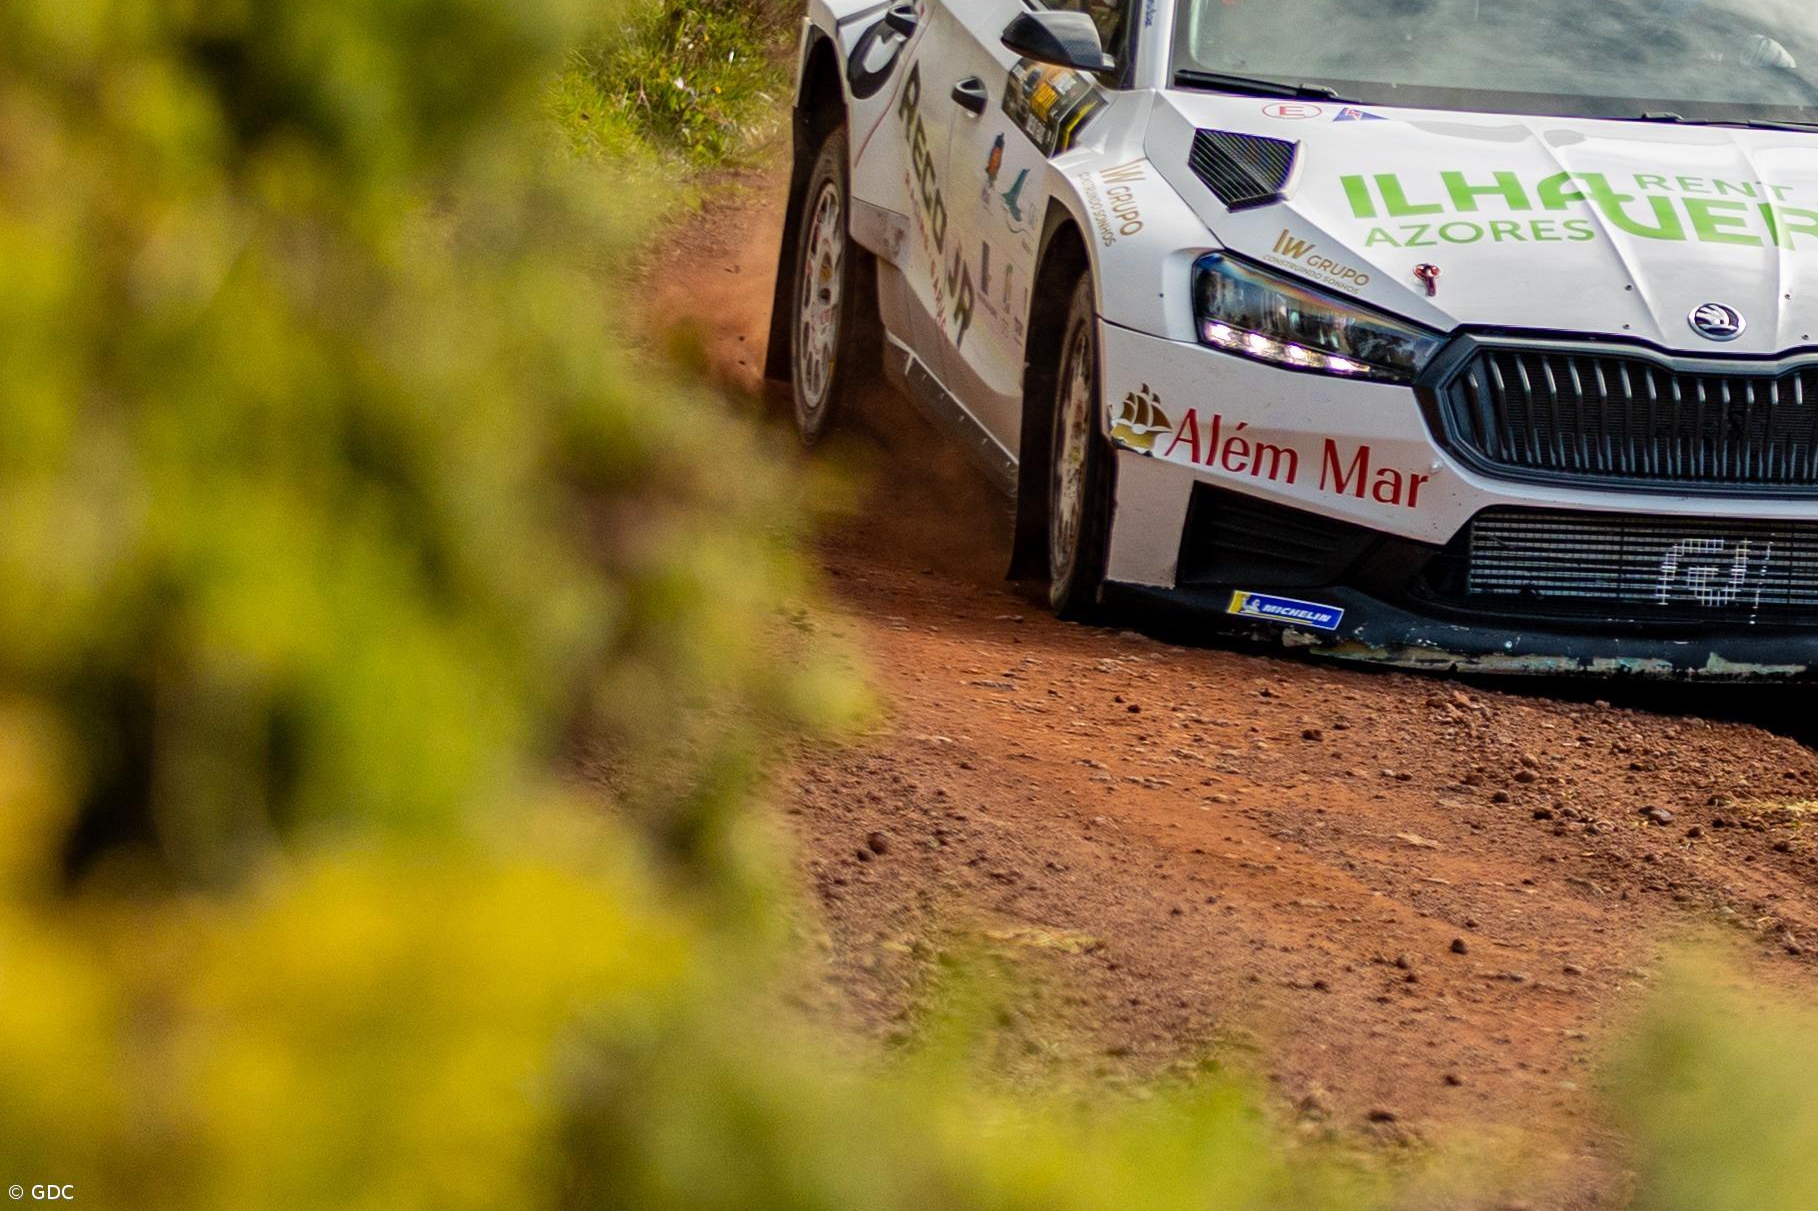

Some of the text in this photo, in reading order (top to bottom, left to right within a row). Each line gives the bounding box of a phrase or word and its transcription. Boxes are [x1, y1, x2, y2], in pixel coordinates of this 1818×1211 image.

[1634, 174, 1796, 202] RENT
[1106, 185, 1144, 237] GRUPO
[1365, 219, 1596, 247] AZORES
[1306, 254, 1369, 286] GRUPO
[1164, 408, 1430, 508] Além Mar
[1262, 603, 1332, 623] MICHELIN
